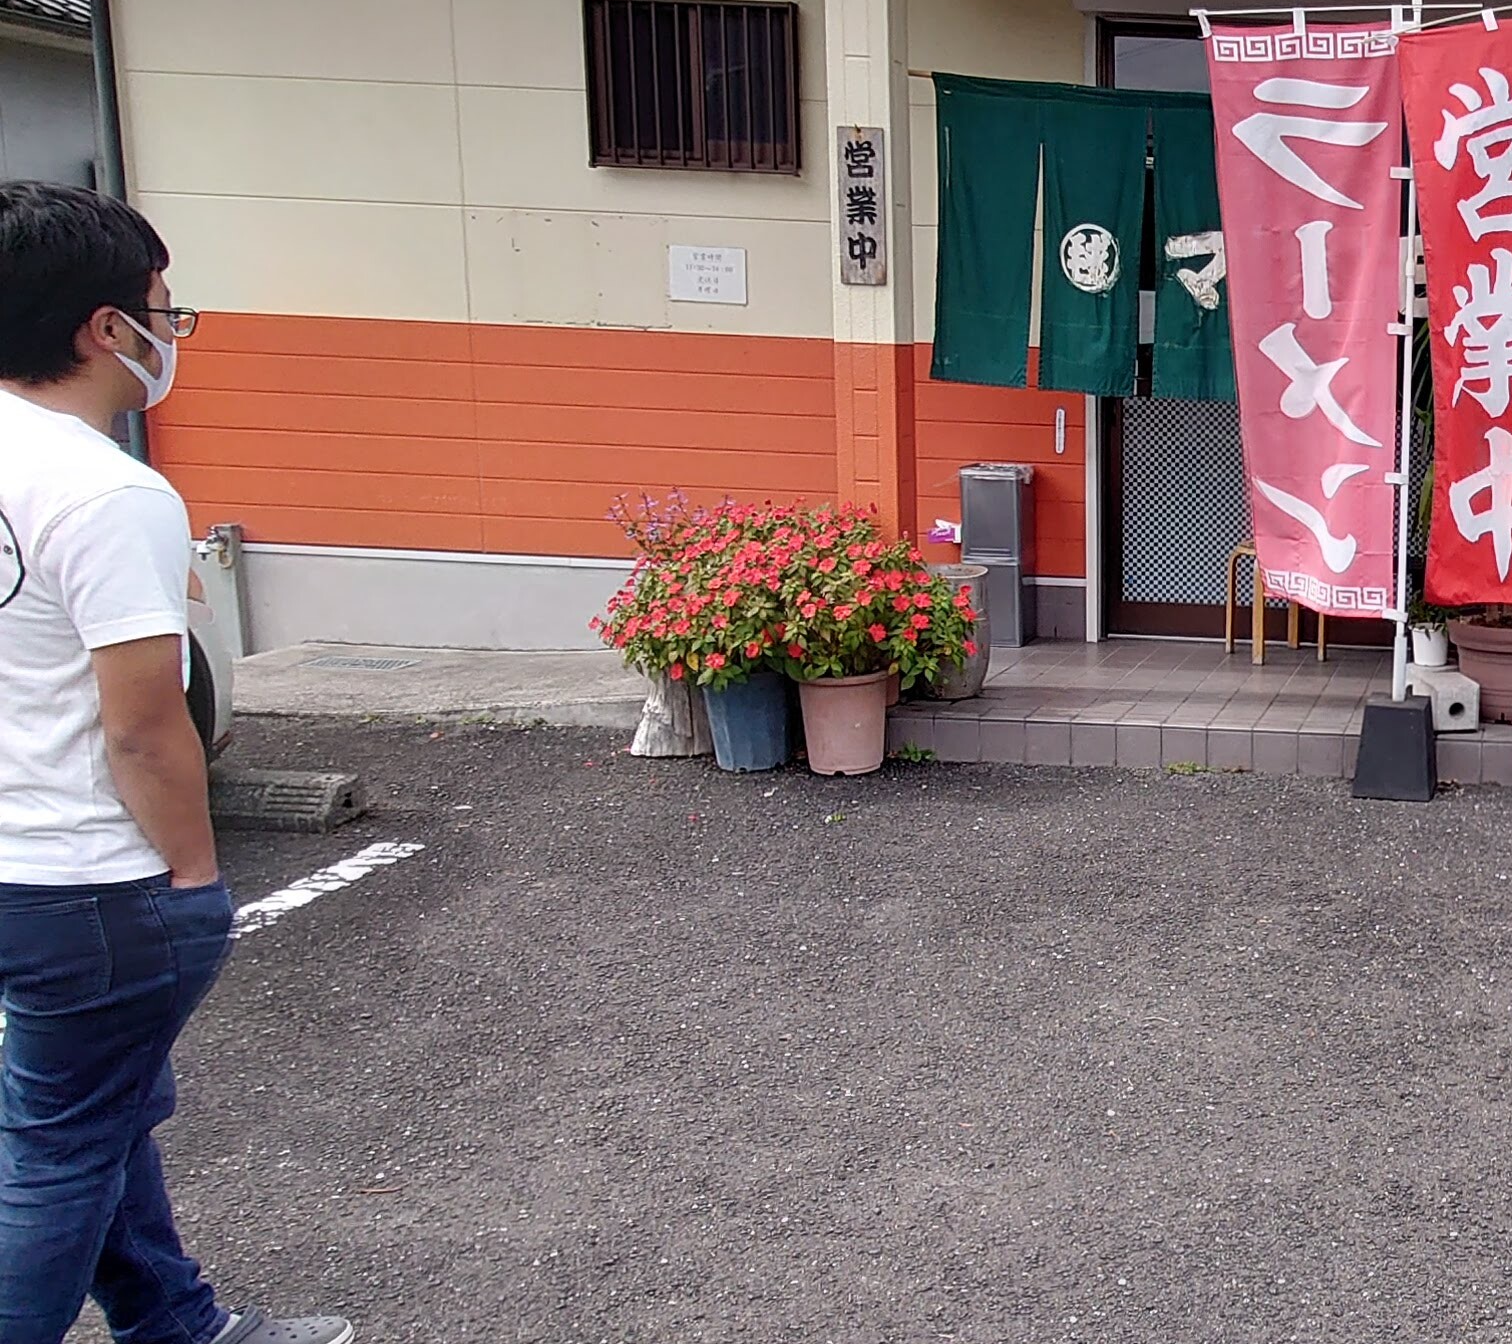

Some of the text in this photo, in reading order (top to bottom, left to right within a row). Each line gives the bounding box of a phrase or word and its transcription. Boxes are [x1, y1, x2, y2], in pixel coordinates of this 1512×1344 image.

[843, 139, 878, 271] 営業中
[1232, 76, 1389, 574] ラーメン
